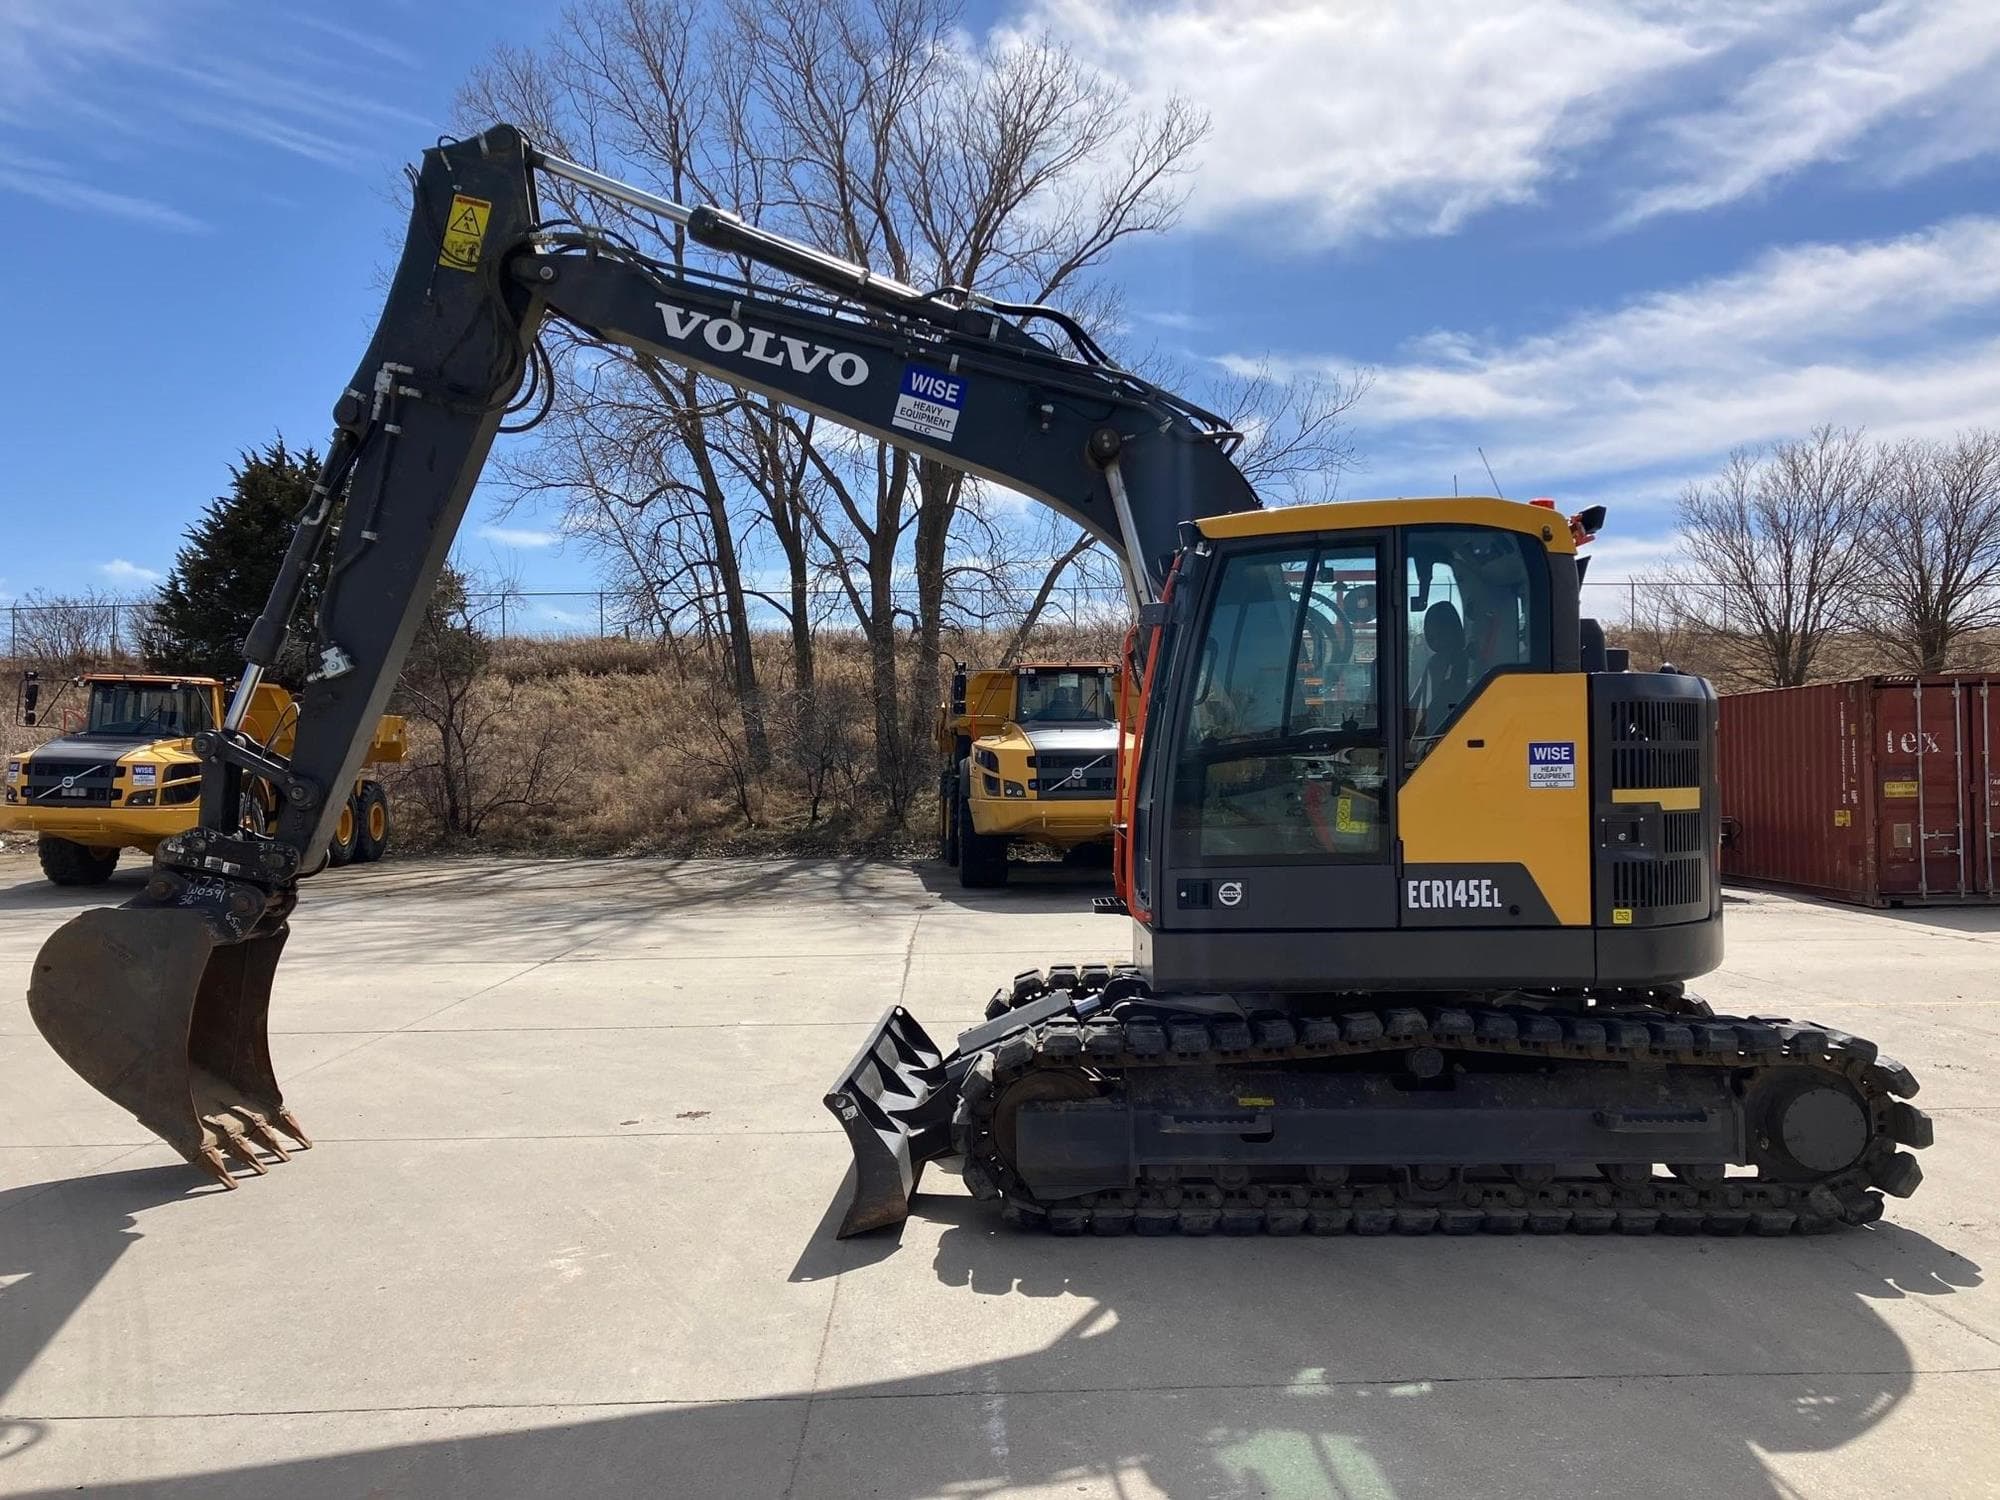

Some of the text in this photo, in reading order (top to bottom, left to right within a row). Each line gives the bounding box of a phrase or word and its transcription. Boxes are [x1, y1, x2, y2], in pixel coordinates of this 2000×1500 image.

[654, 301, 869, 386] VOLVO
[911, 371, 960, 404] WISE
[913, 400, 943, 416] HEAVY
[899, 406, 951, 429] EQUIPMENT
[913, 423, 932, 434] LLC
[1534, 747, 1570, 760] WISE
[135, 766, 154, 774] WISE
[1540, 765, 1563, 773] HEAVY
[1532, 772, 1571, 780] EQUIPMENT
